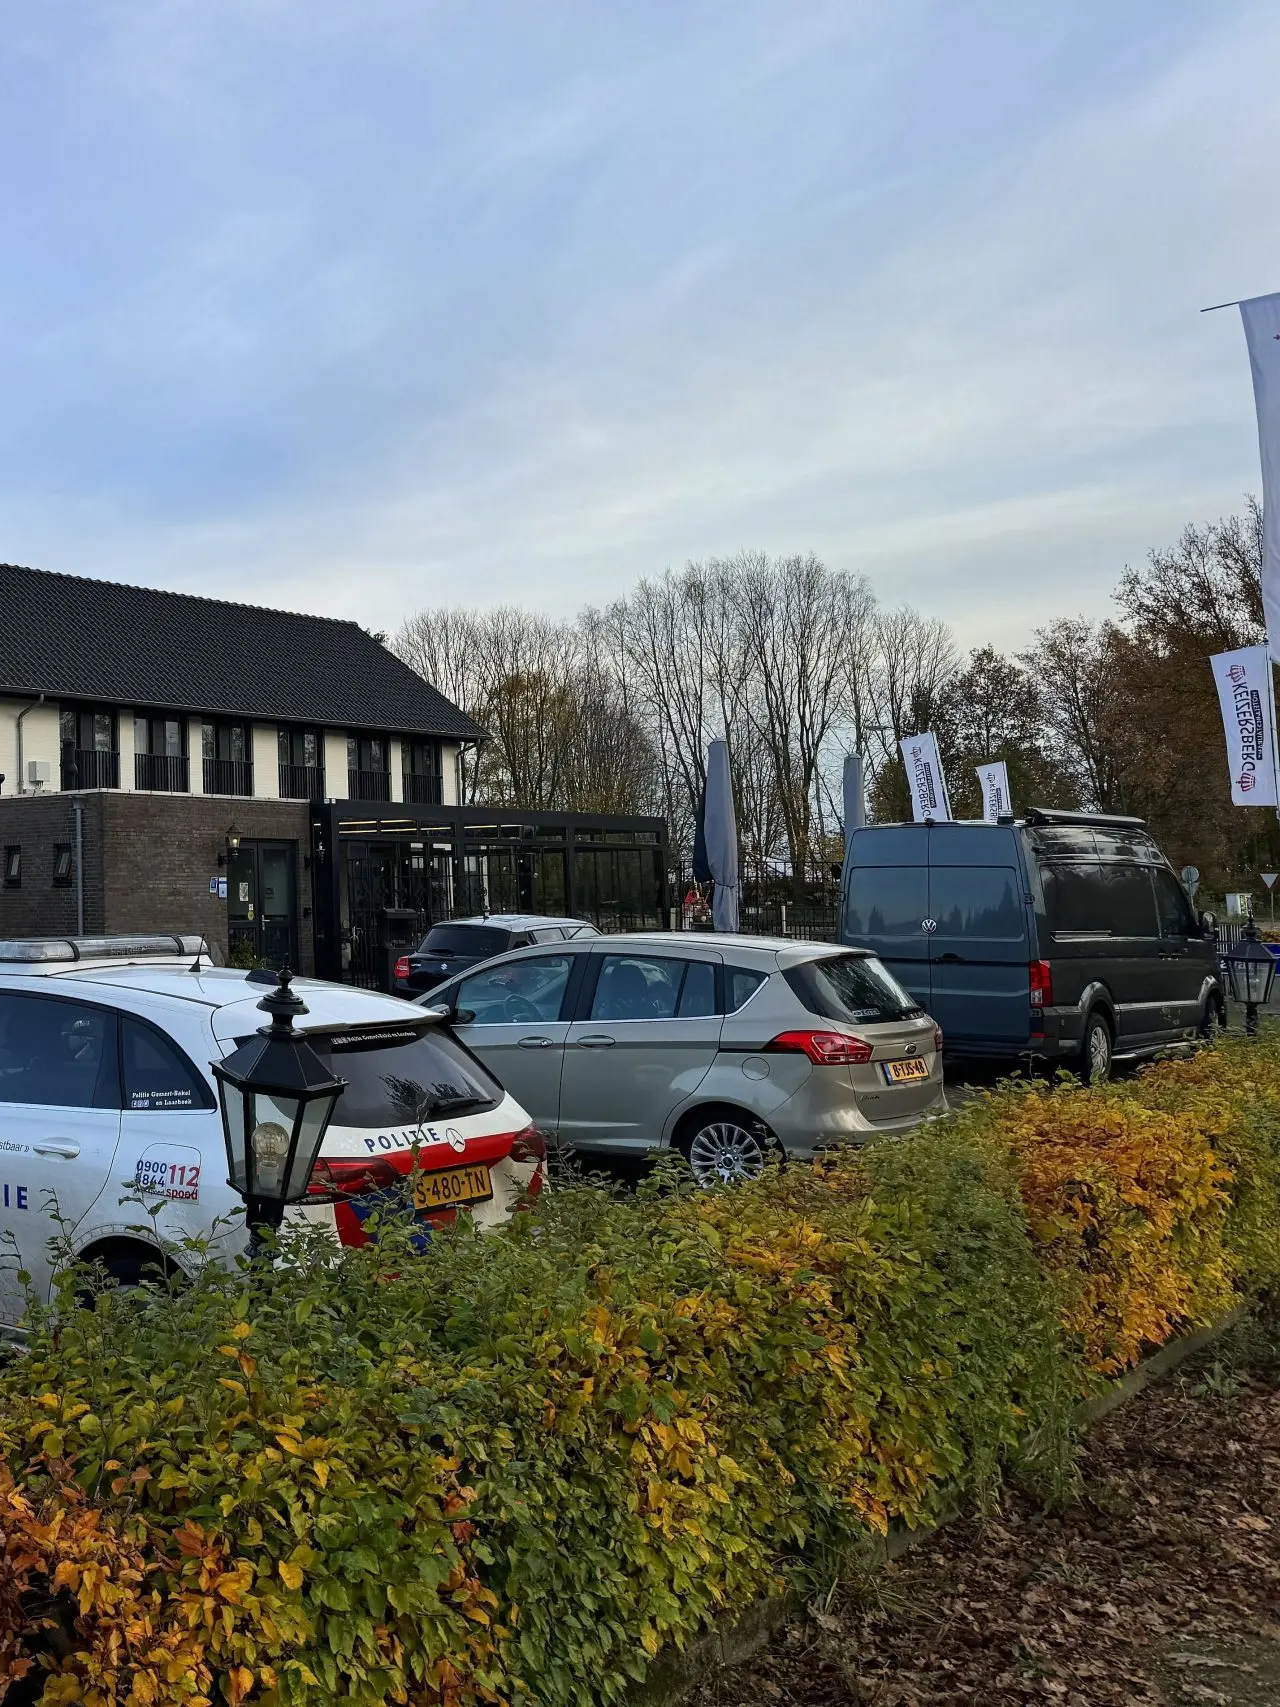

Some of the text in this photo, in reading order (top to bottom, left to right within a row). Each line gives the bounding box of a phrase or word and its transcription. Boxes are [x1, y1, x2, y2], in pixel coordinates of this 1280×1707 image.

[892, 1060, 925, 1078] 8-TJS-48
[363, 1127, 441, 1153] POLITIE
[136, 1160, 200, 1188] 0900 112
[416, 1170, 486, 1204] S-480-TN
[166, 1188, 198, 1200] spoed
